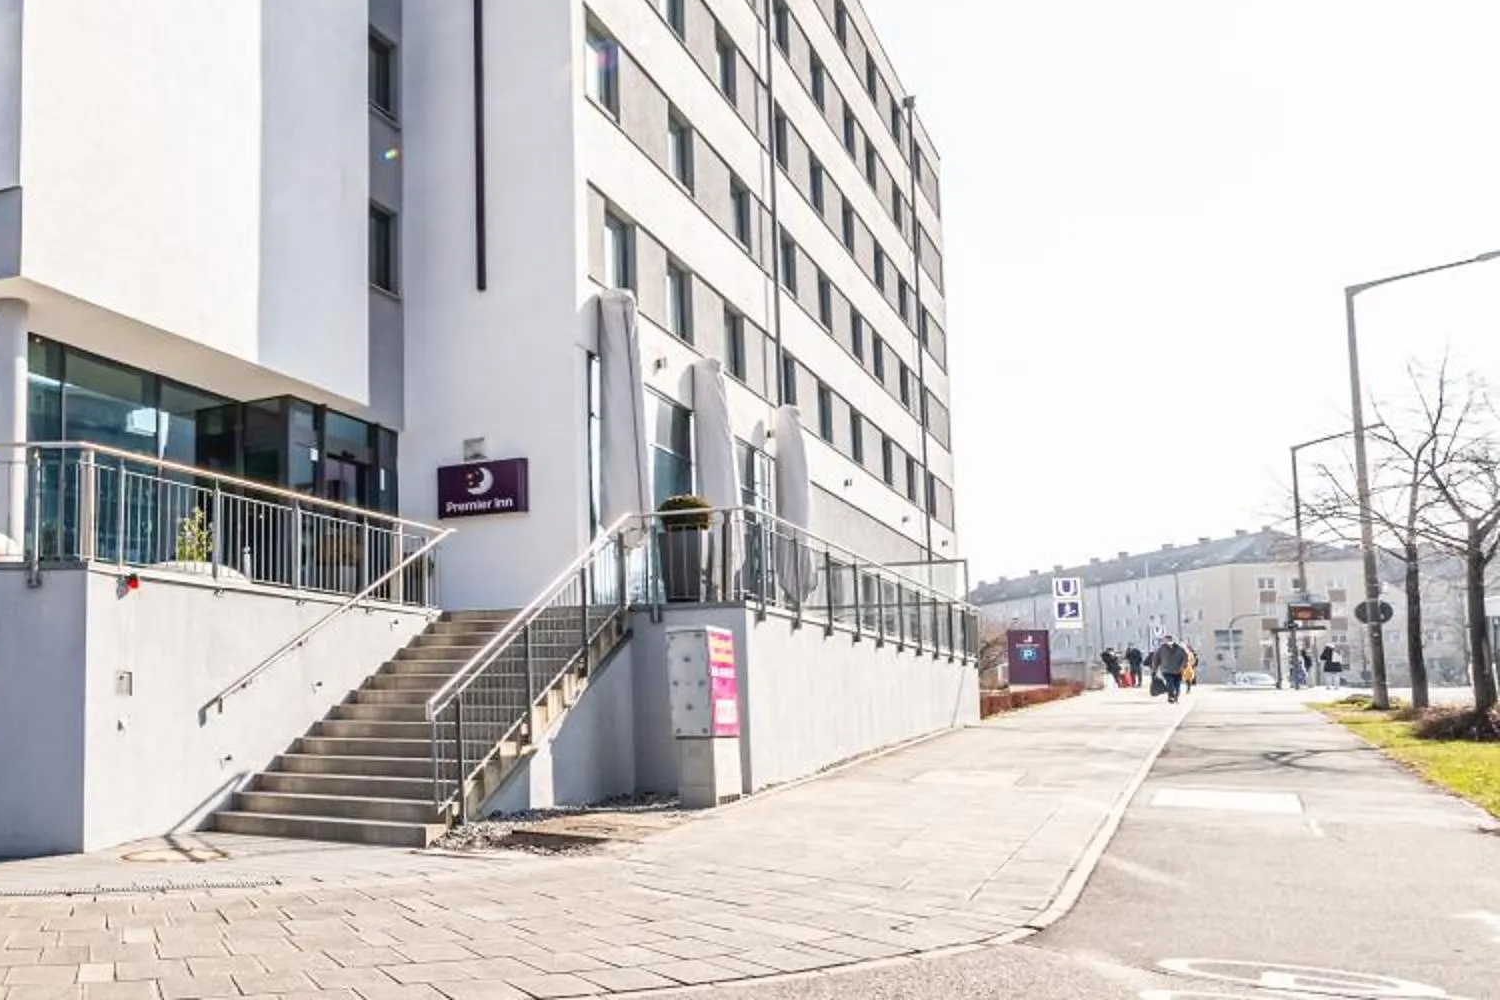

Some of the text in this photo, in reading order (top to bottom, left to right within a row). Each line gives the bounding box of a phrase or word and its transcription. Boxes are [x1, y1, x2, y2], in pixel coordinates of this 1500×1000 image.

[445, 497, 513, 513] Premier Inn
[1058, 579, 1075, 596] U
